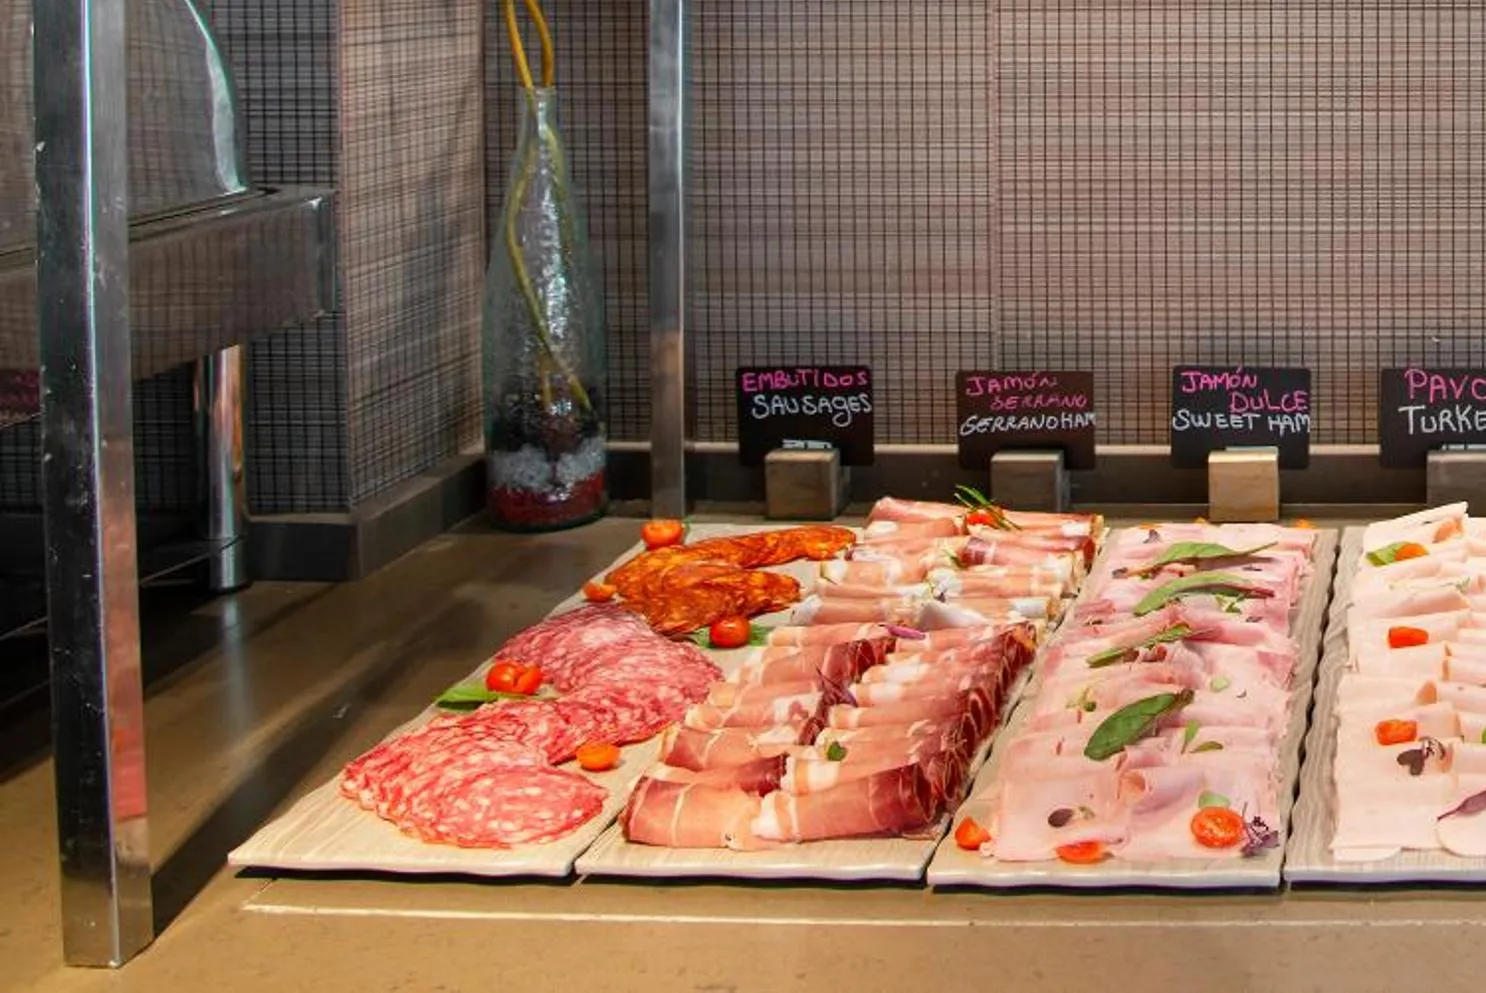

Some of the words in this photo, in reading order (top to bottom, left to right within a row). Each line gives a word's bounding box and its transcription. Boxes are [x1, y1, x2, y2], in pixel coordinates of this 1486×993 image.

[1181, 365, 1257, 393] JAMÓN
[1229, 388, 1308, 413] DULCE
[1172, 408, 1261, 431] SWEET
[1267, 412, 1311, 437] HAM
